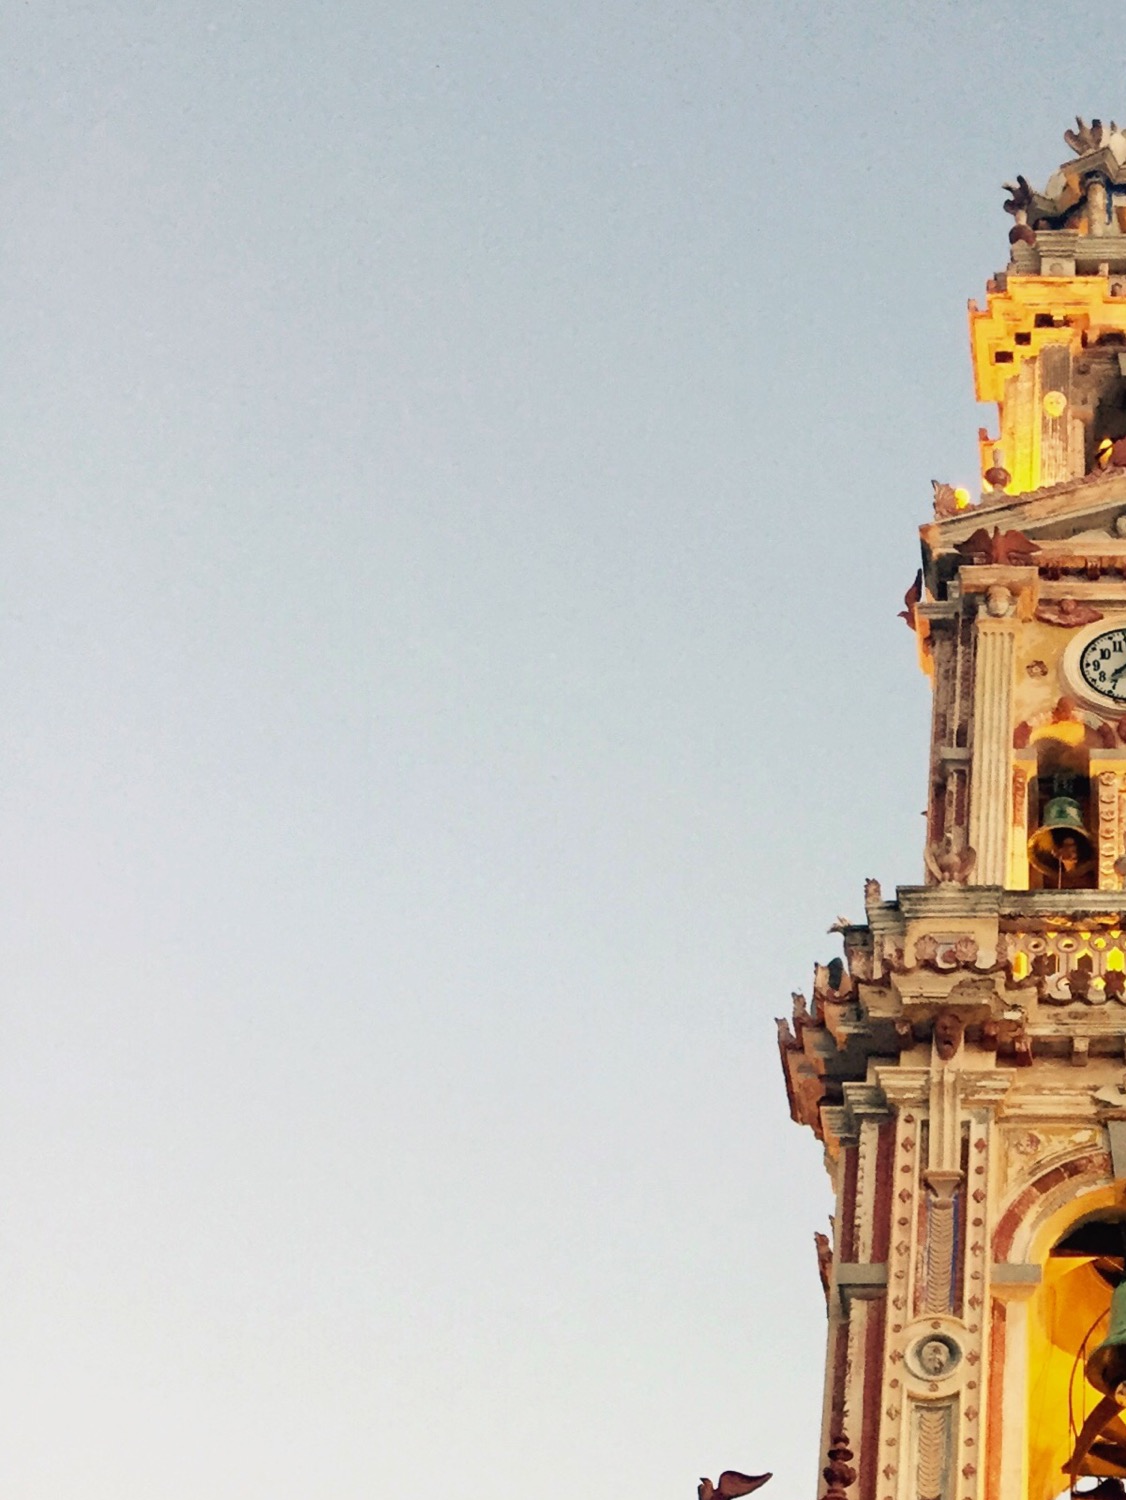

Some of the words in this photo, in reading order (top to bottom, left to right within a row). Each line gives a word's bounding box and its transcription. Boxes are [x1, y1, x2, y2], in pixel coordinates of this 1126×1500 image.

[1112, 640, 1123, 653] 11
[1100, 648, 1111, 660] 10
[1092, 659, 1100, 671] 9
[1098, 670, 1106, 682] 8
[1110, 679, 1118, 690] 7
